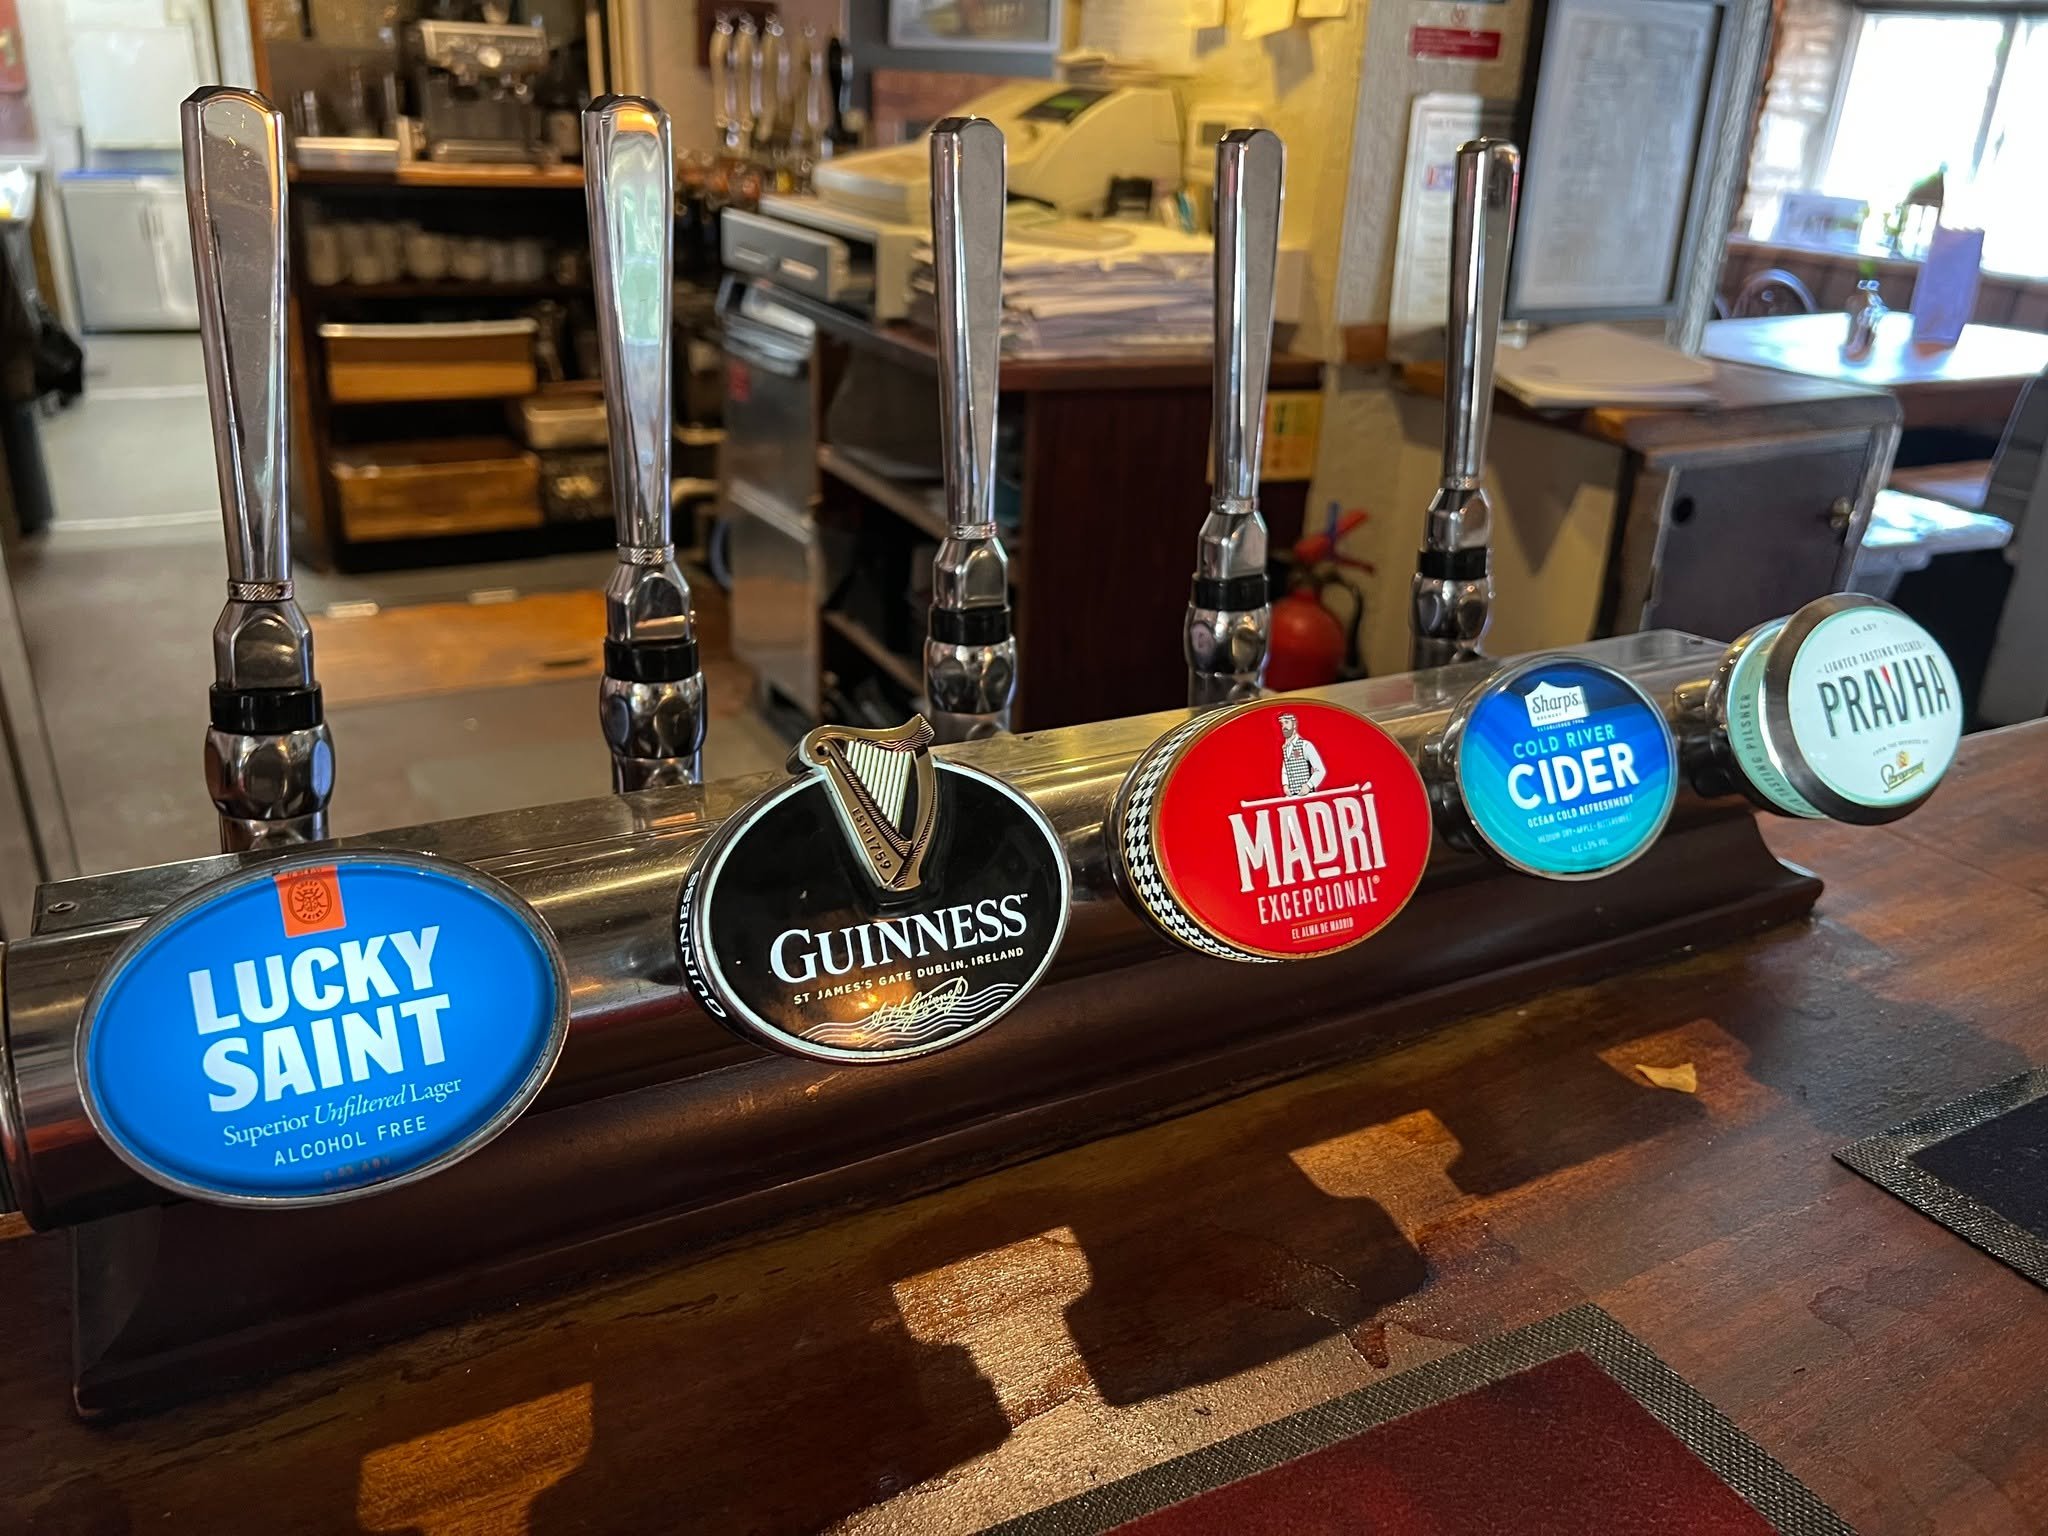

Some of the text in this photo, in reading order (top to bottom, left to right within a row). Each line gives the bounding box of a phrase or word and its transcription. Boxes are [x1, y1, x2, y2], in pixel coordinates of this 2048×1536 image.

[1824, 656, 1858, 674] LIGHTER
[1860, 646, 1893, 664] TASTING
[1532, 691, 1580, 716] Sharp's
[1740, 694, 1756, 750] PILSNER
[1817, 655, 1950, 739] PRAVHA
[1513, 724, 1616, 759] COLD RIVER
[1507, 742, 1640, 810] CIDER
[1228, 781, 1387, 893] MADRÍ
[1527, 794, 1633, 829] OCEAN COLD REFRESHMENT
[865, 836, 893, 871] 1759
[1257, 879, 1378, 925] EXCEPCIONAL
[1291, 917, 1354, 940] EL ALMA DE MADRID
[679, 871, 728, 1019] GUINNESS
[770, 892, 1028, 985] GUINNESS
[188, 926, 440, 1036] LUCKY
[793, 946, 1025, 1006] ST JAMES'S GATE DUBLIN, IRELAND
[203, 994, 451, 1112] SAINT
[223, 1076, 462, 1147] Superior Unfiltered Lager
[274, 1116, 428, 1167] ALCOHOL FREE
